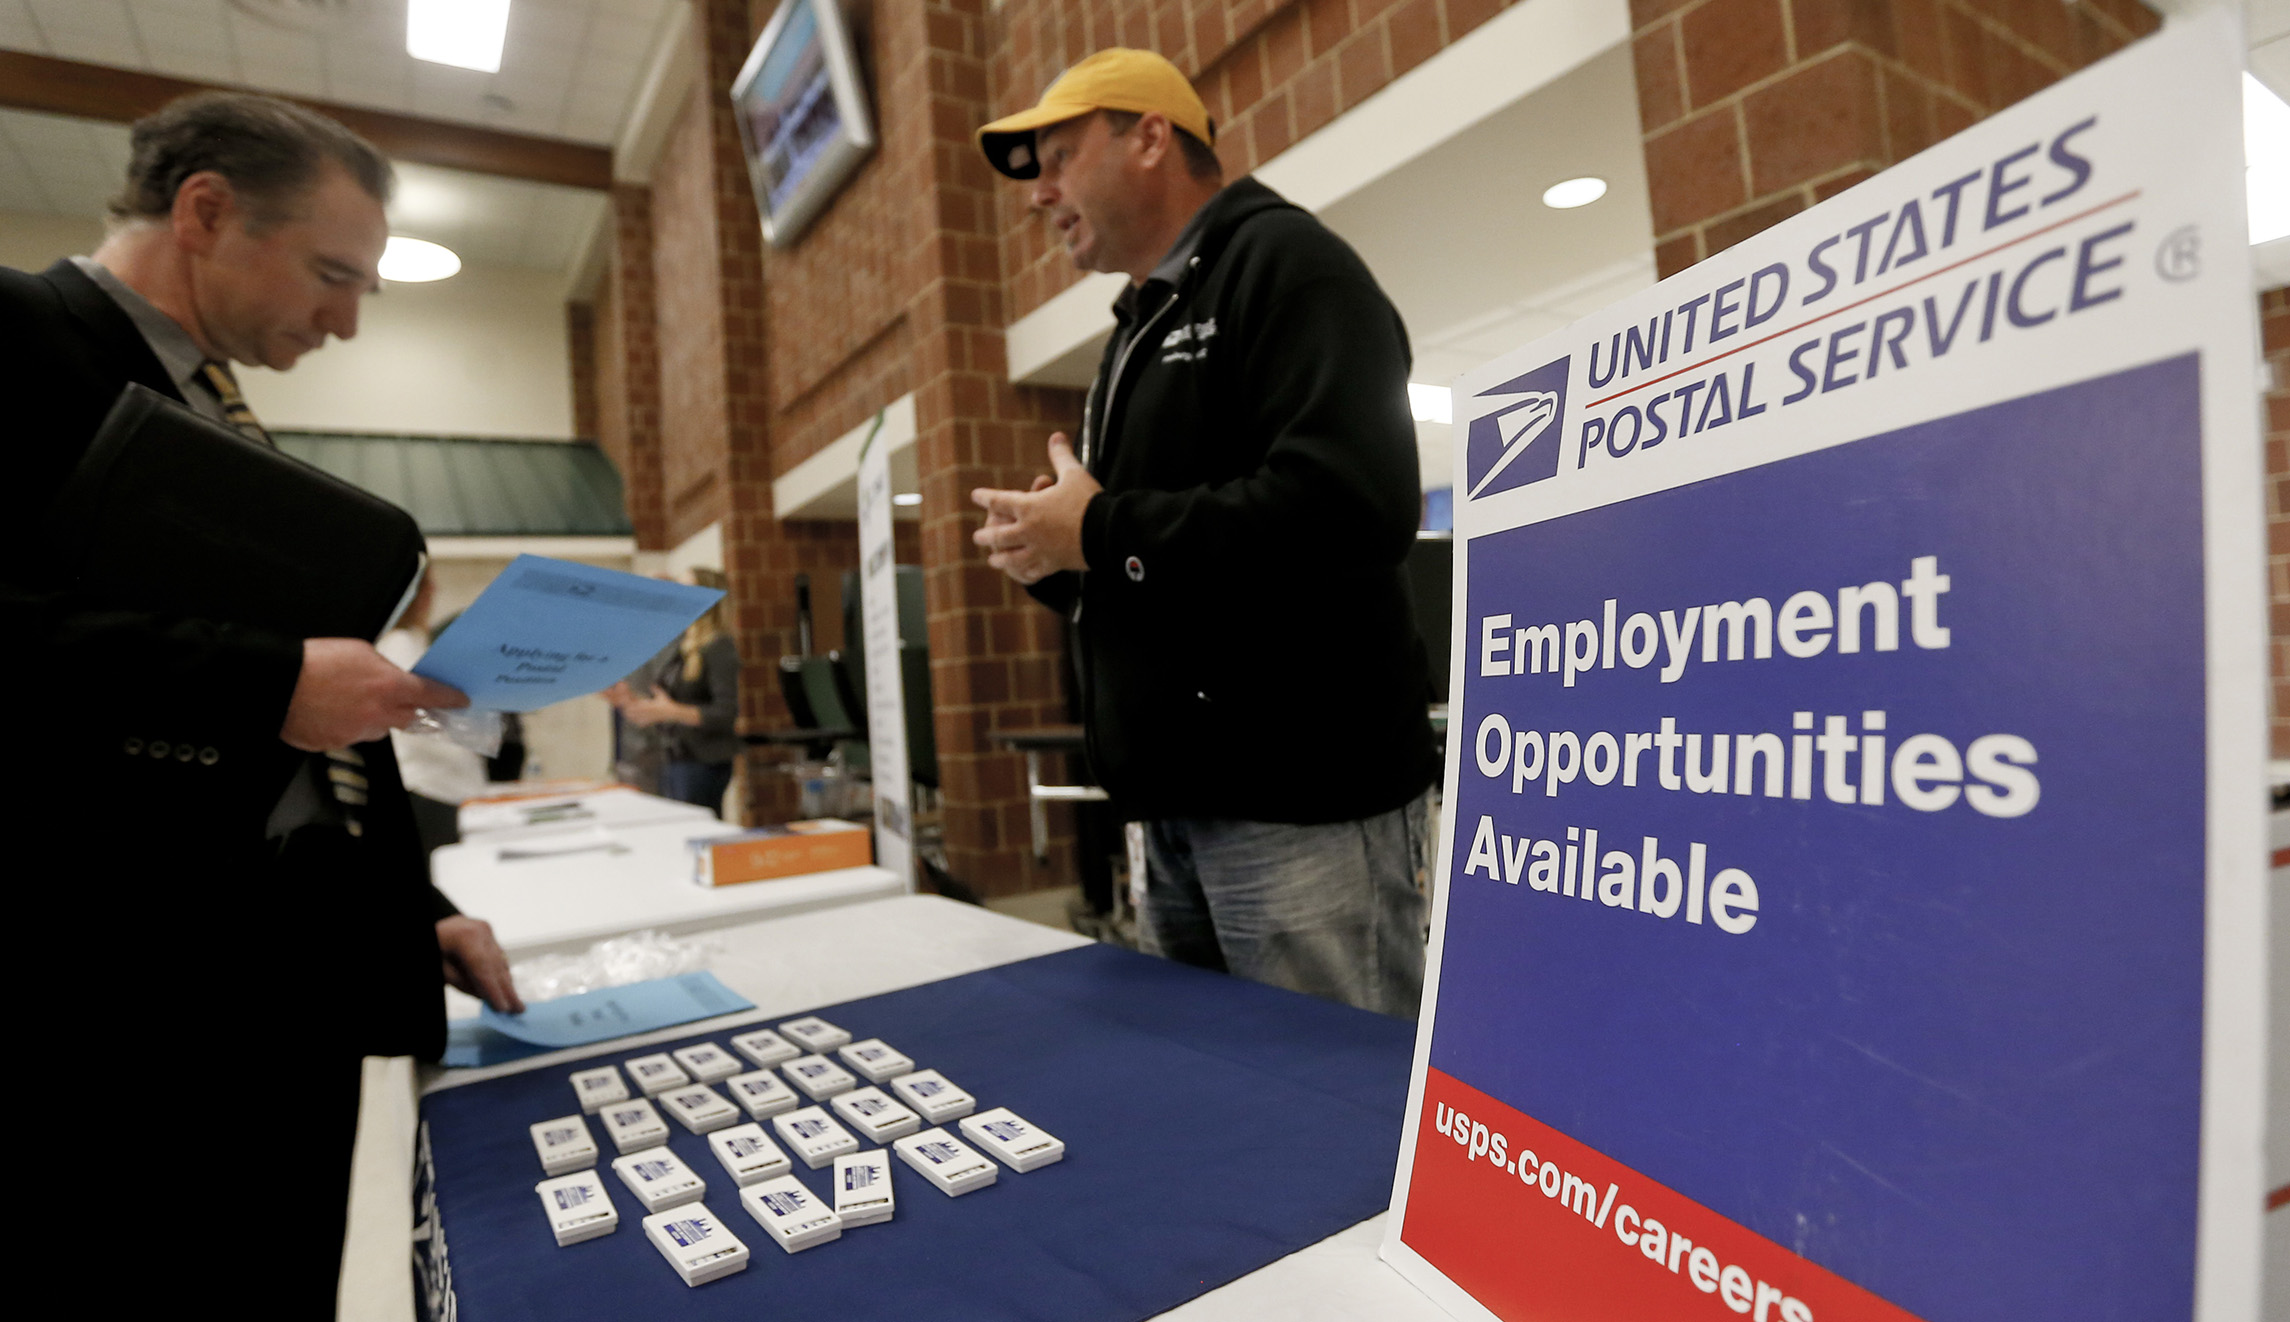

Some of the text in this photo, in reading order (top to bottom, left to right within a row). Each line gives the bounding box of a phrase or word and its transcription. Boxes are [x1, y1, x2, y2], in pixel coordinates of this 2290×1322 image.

[1587, 115, 2099, 390] UNITED STATES
[1577, 362, 1767, 470] POSTAL
[1781, 221, 2137, 406] SERVICE
[1479, 555, 1951, 688] Employment
[1474, 710, 2042, 819] Opportunities
[1463, 814, 1760, 935] Available
